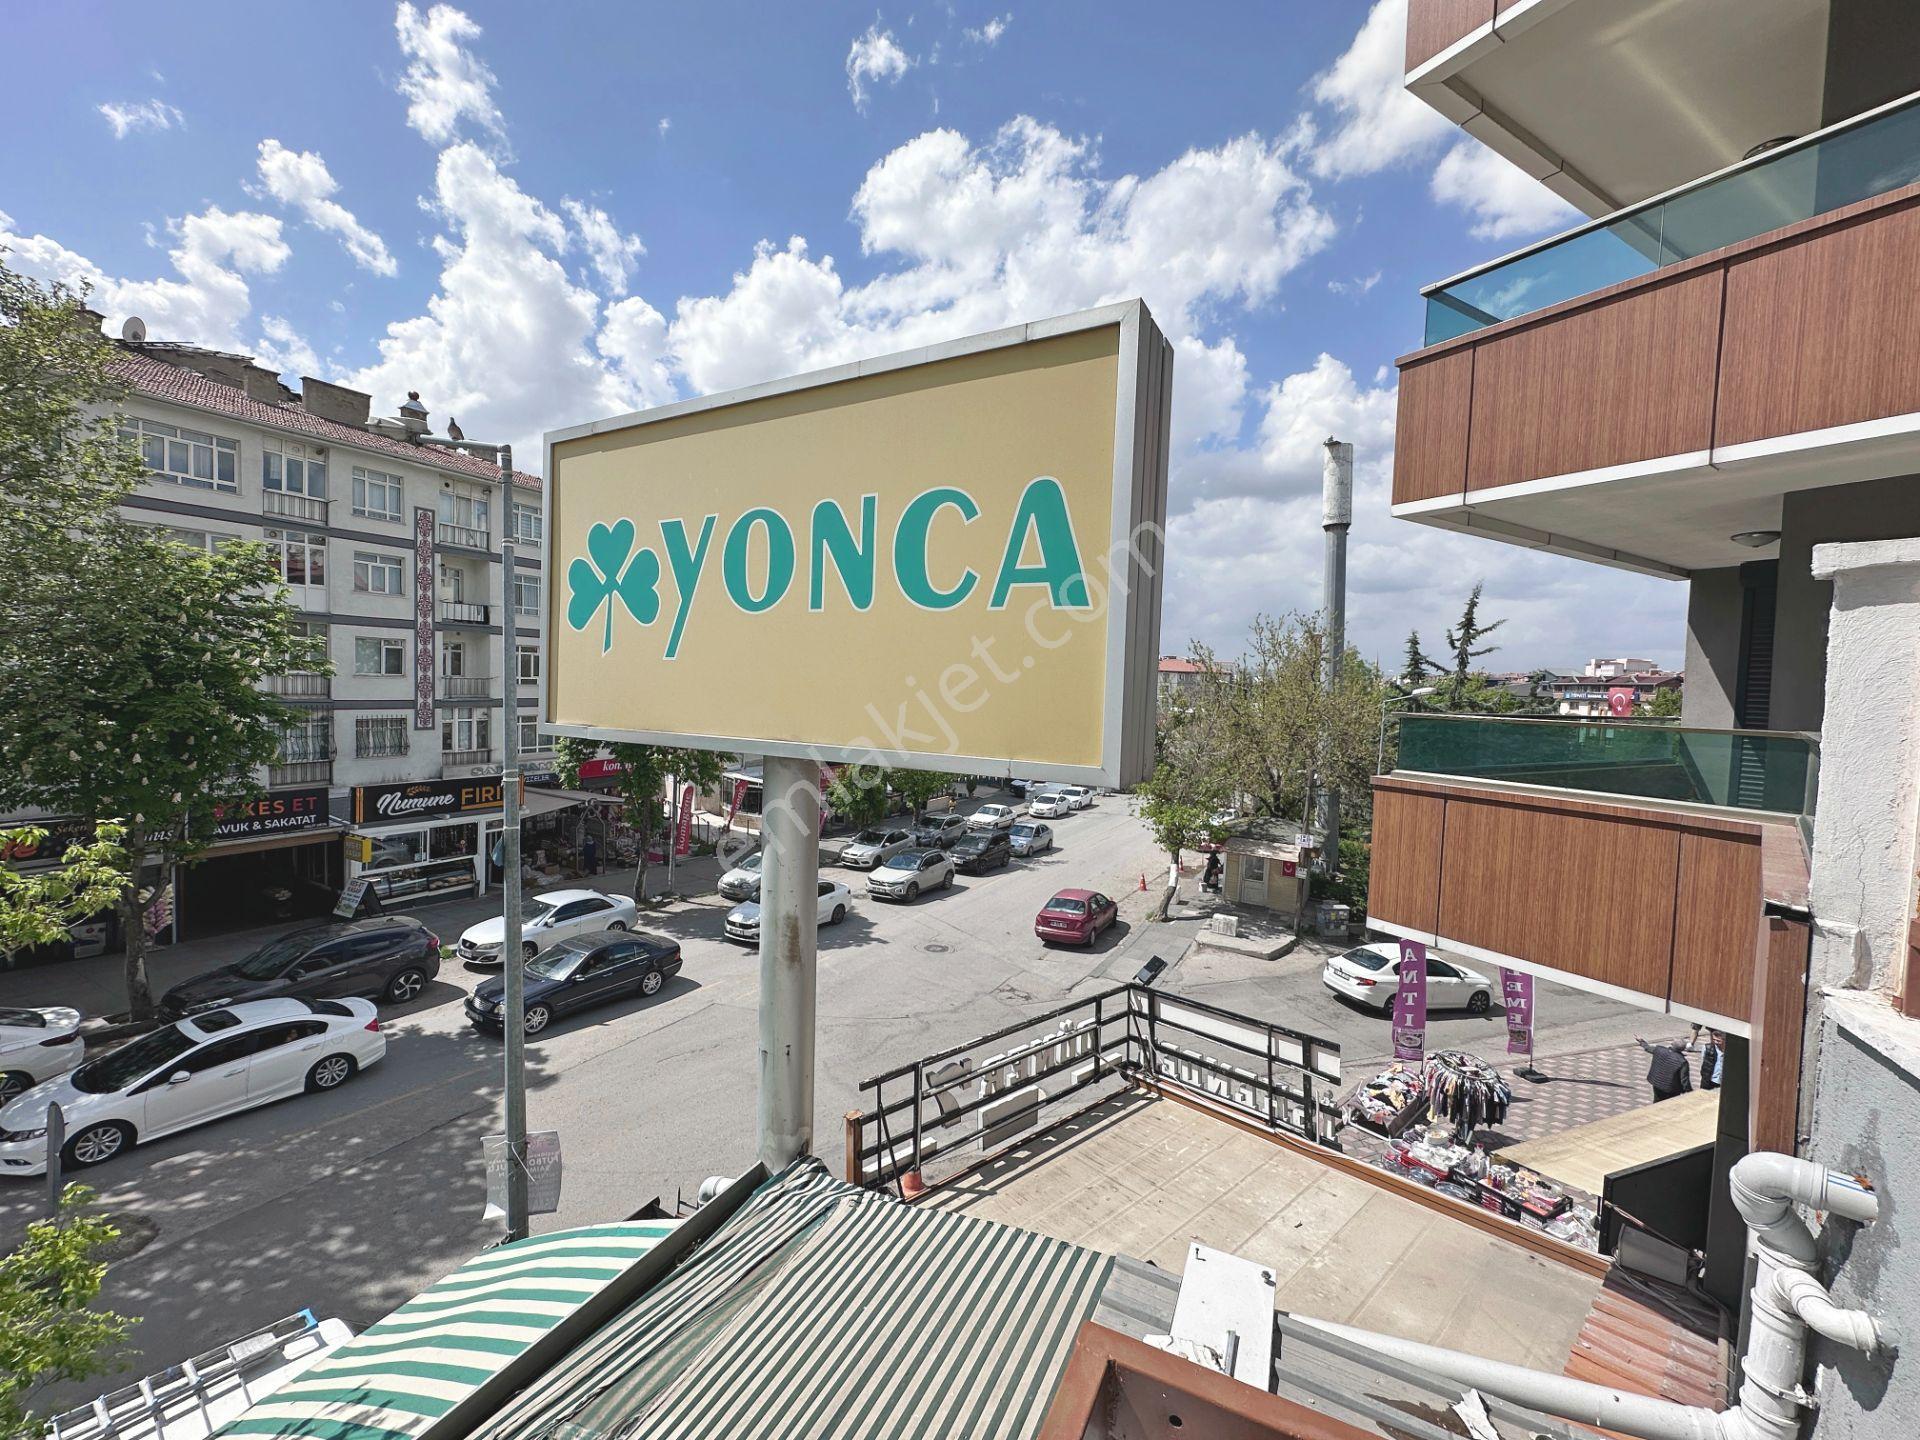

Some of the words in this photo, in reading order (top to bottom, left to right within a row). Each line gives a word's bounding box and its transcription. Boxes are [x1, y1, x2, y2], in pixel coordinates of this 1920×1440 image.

[658, 475, 1093, 660] YONCA
[292, 797, 317, 812] ET
[376, 792, 455, 816] Numune
[461, 785, 501, 805] FIRI
[213, 822, 249, 835] AVUK
[252, 821, 262, 830] &
[265, 814, 317, 829] SAKATAT
